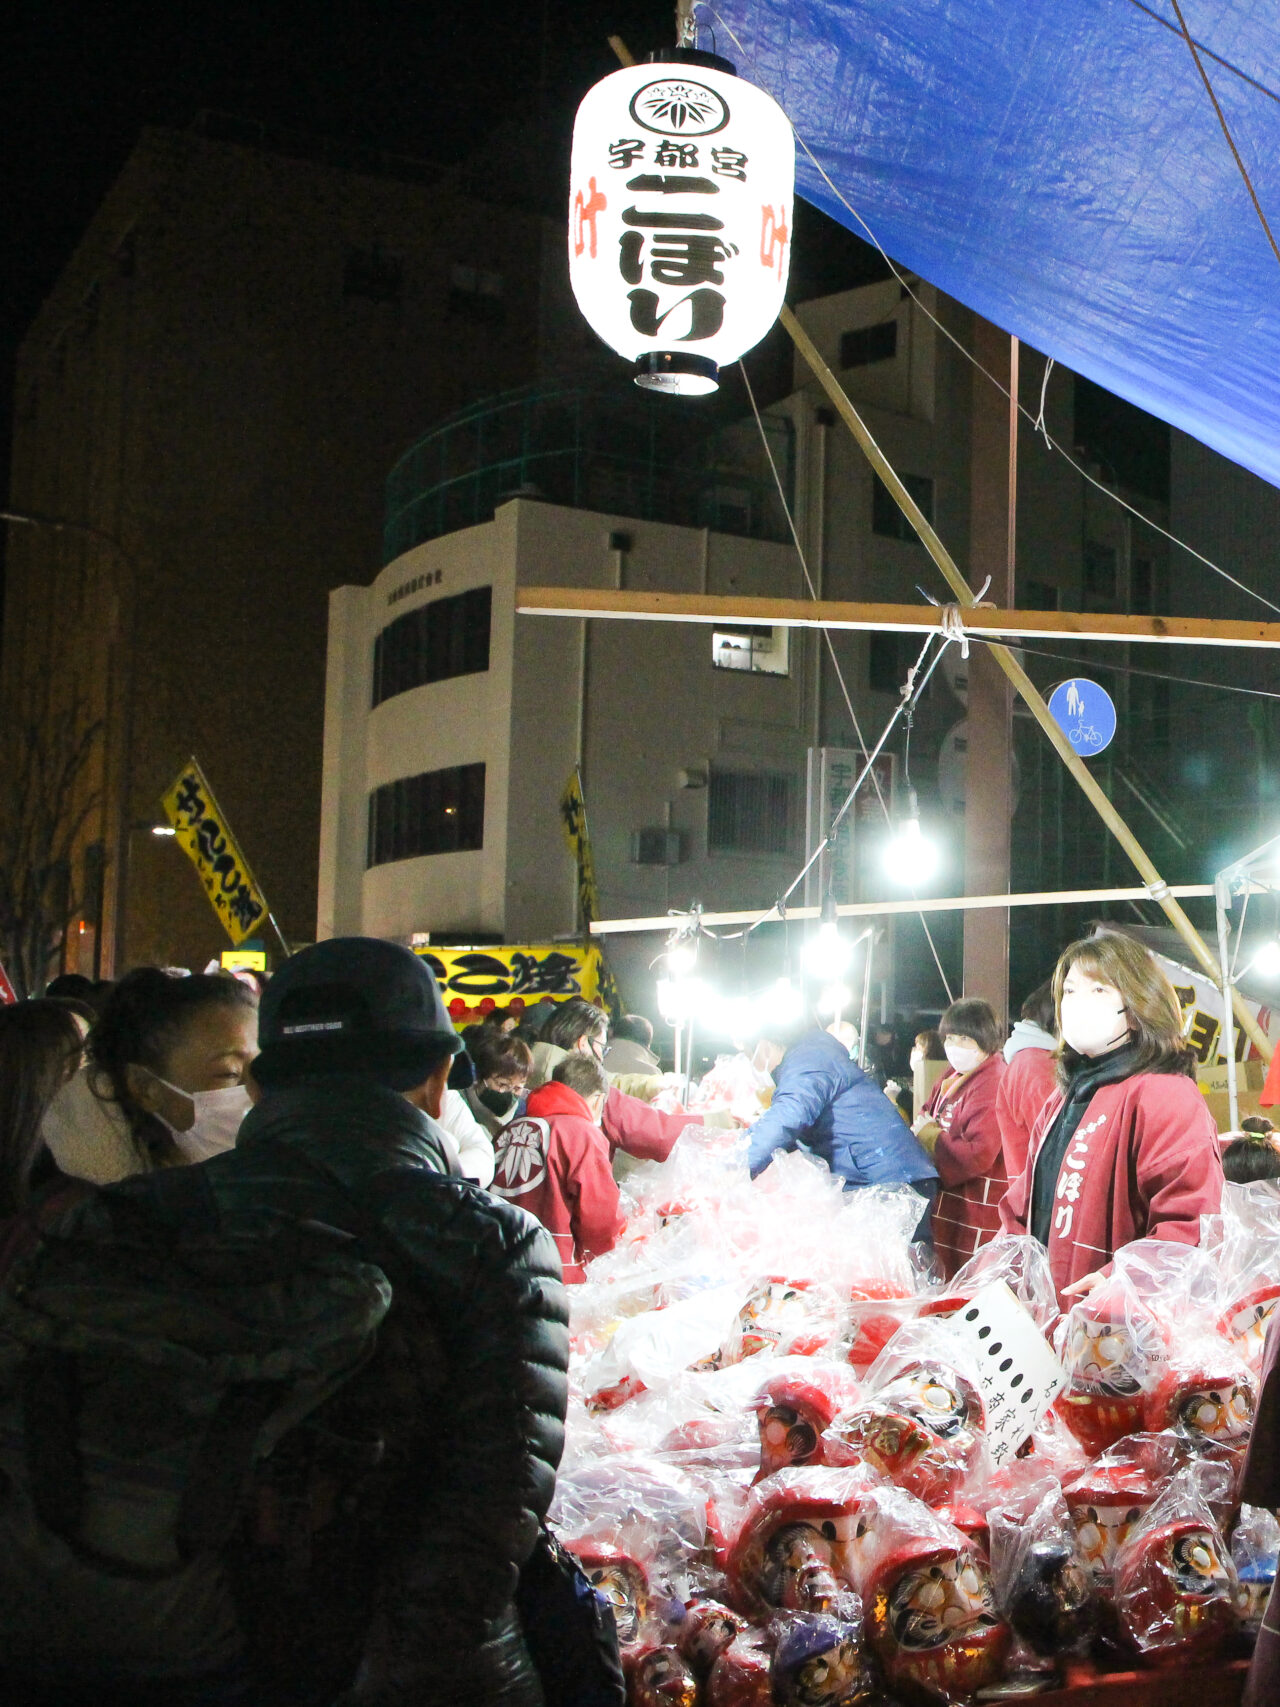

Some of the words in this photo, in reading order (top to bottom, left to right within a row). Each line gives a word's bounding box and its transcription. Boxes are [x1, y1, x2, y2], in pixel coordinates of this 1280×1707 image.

[608, 139, 749, 183] 宇都宮
[1055, 1142, 1089, 1239] こぼり
